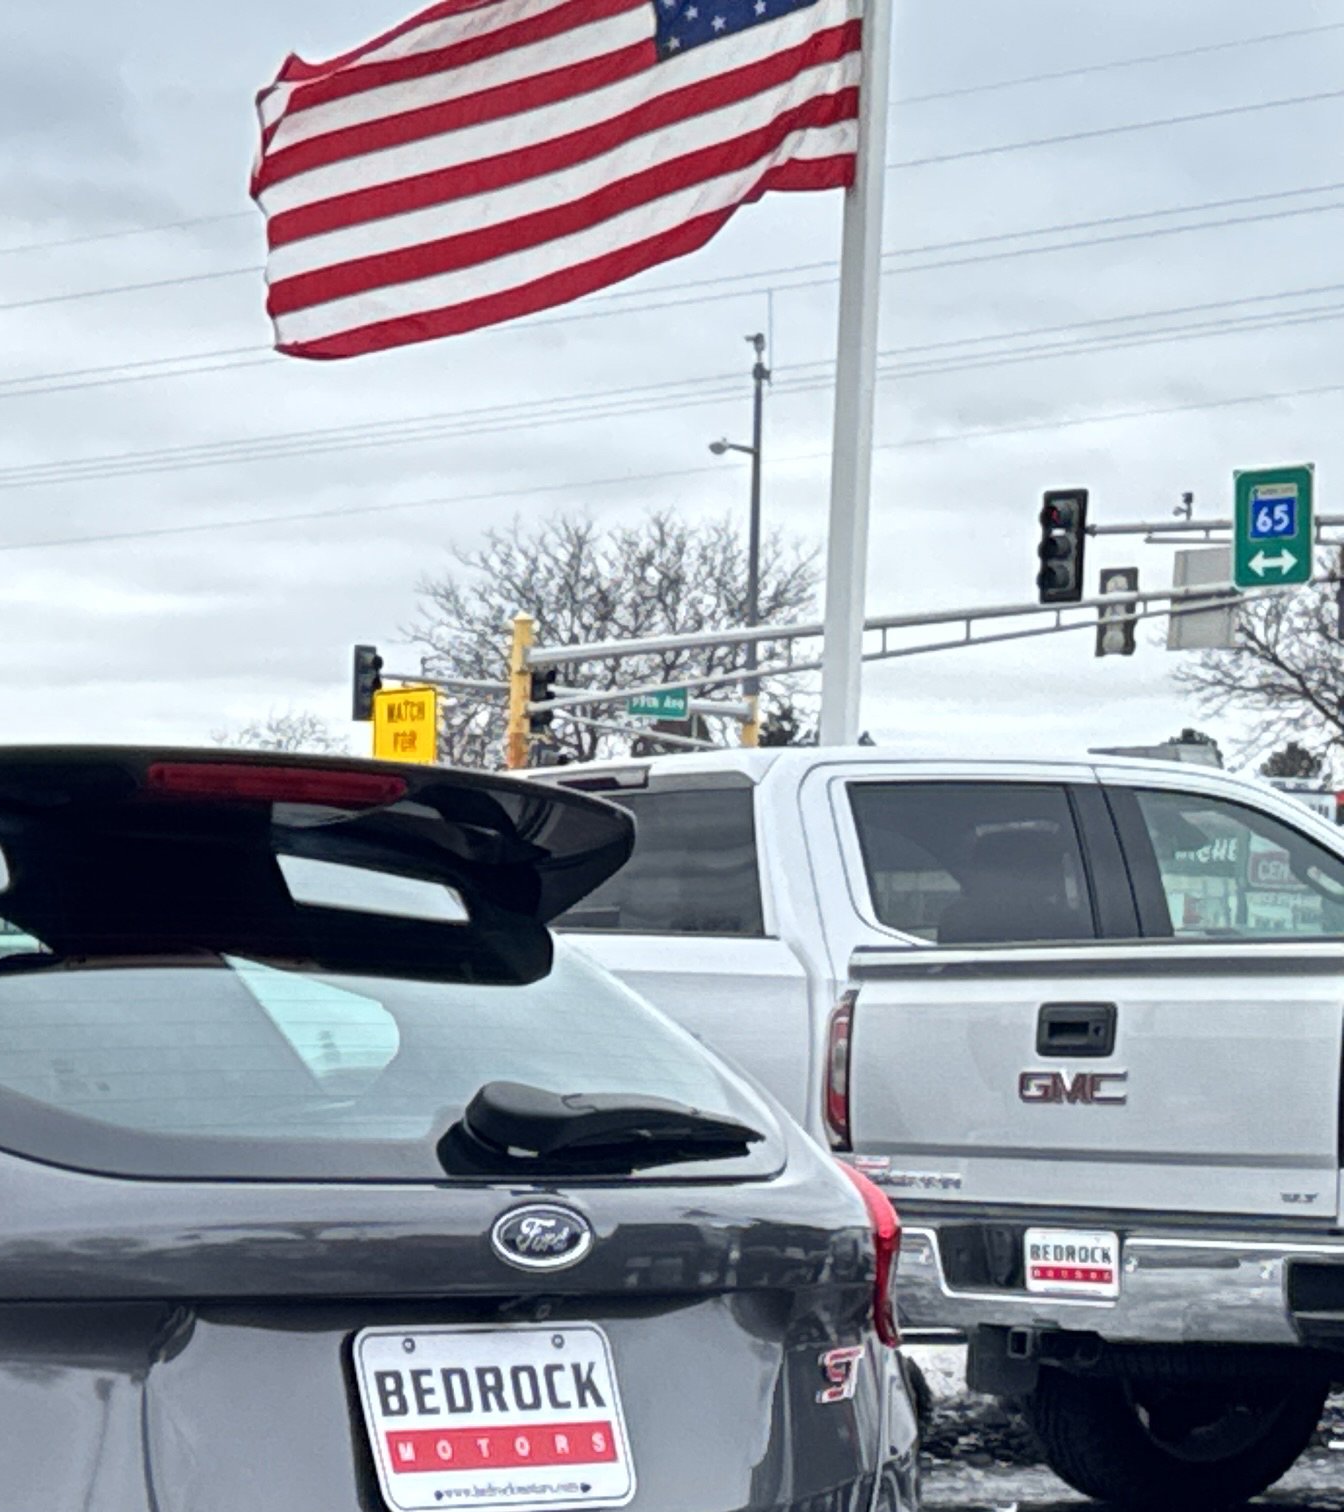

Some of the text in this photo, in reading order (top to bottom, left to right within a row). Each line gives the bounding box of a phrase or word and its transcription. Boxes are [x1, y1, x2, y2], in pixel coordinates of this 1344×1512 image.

[1256, 504, 1291, 533] 65
[387, 699, 426, 723] WATCH
[1019, 1069, 1128, 1105] GMC
[516, 1217, 570, 1251] Ford
[1030, 1244, 1112, 1264] BEDROCK
[374, 1362, 606, 1417] BEDROCK
[397, 1433, 607, 1462] MOTORS
